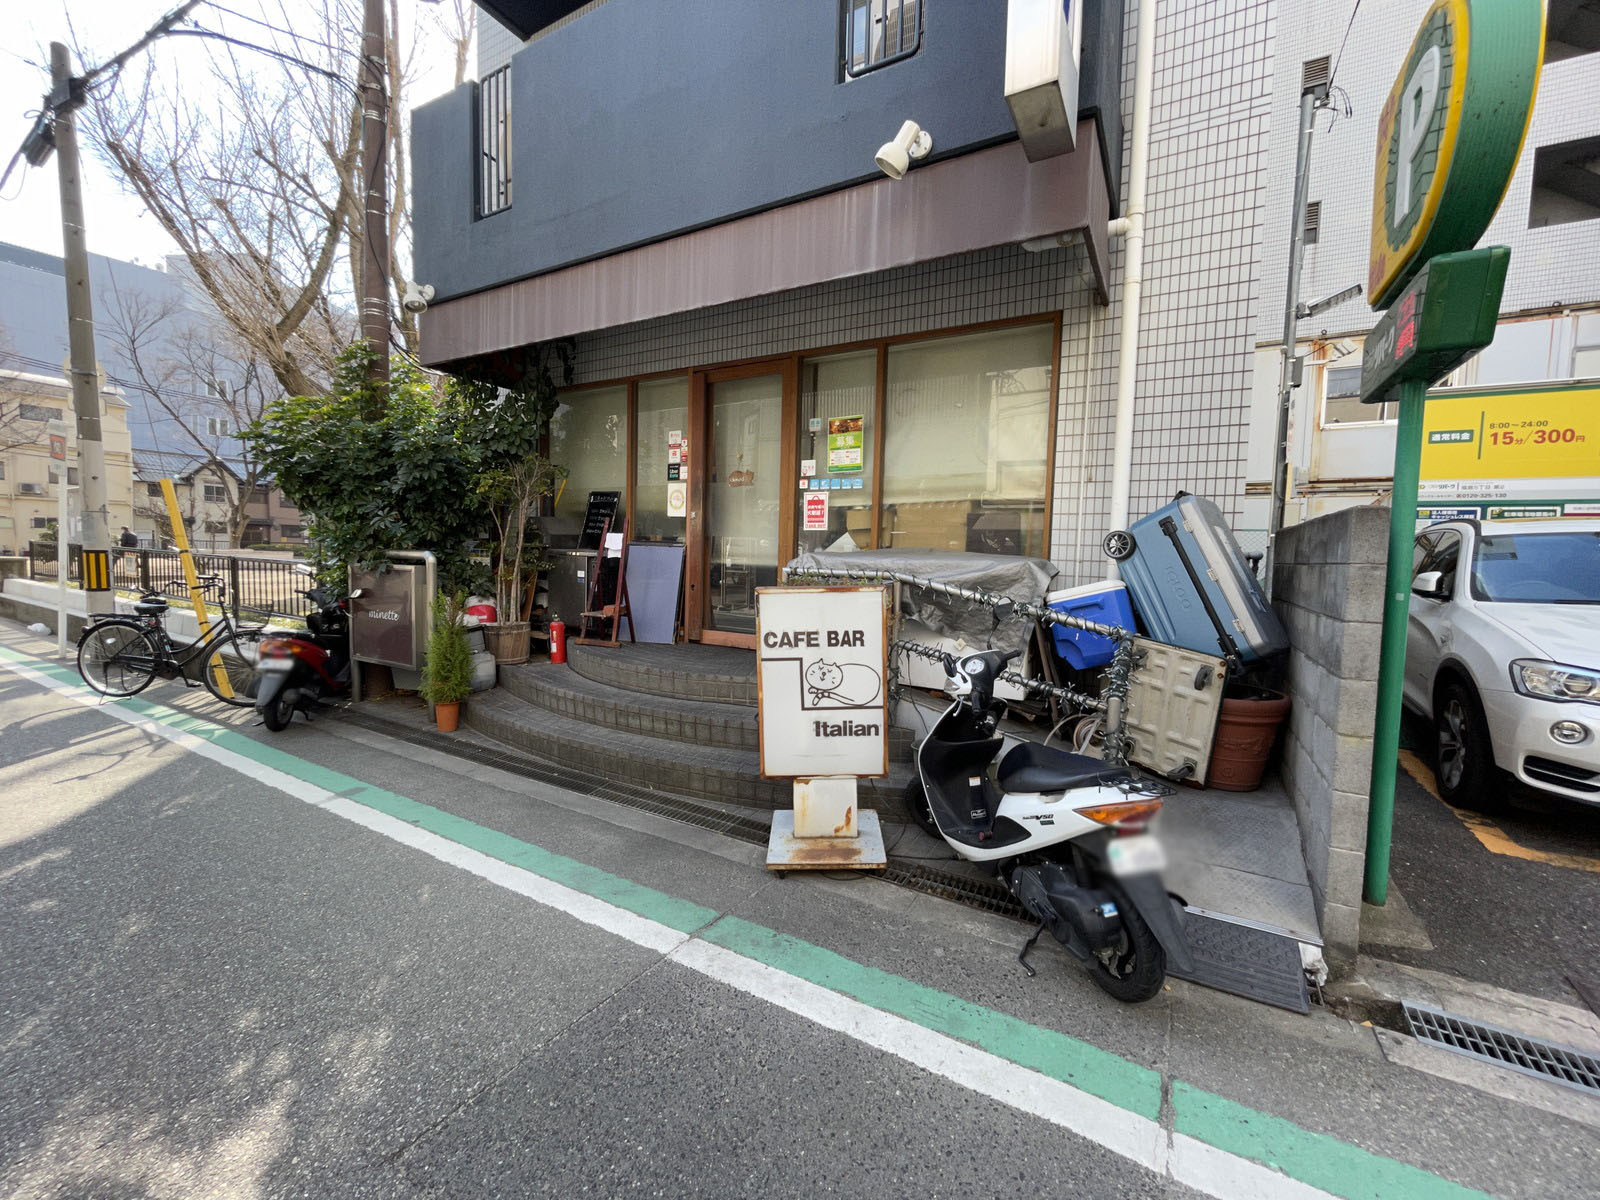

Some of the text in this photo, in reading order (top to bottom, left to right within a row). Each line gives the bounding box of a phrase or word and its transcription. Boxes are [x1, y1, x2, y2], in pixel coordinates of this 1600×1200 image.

[1394, 44, 1440, 229] P
[1431, 432, 1471, 442] 通常料金
[368, 609, 400, 622] minette
[763, 629, 865, 649] CAFE BAR
[813, 720, 880, 737] Italian
